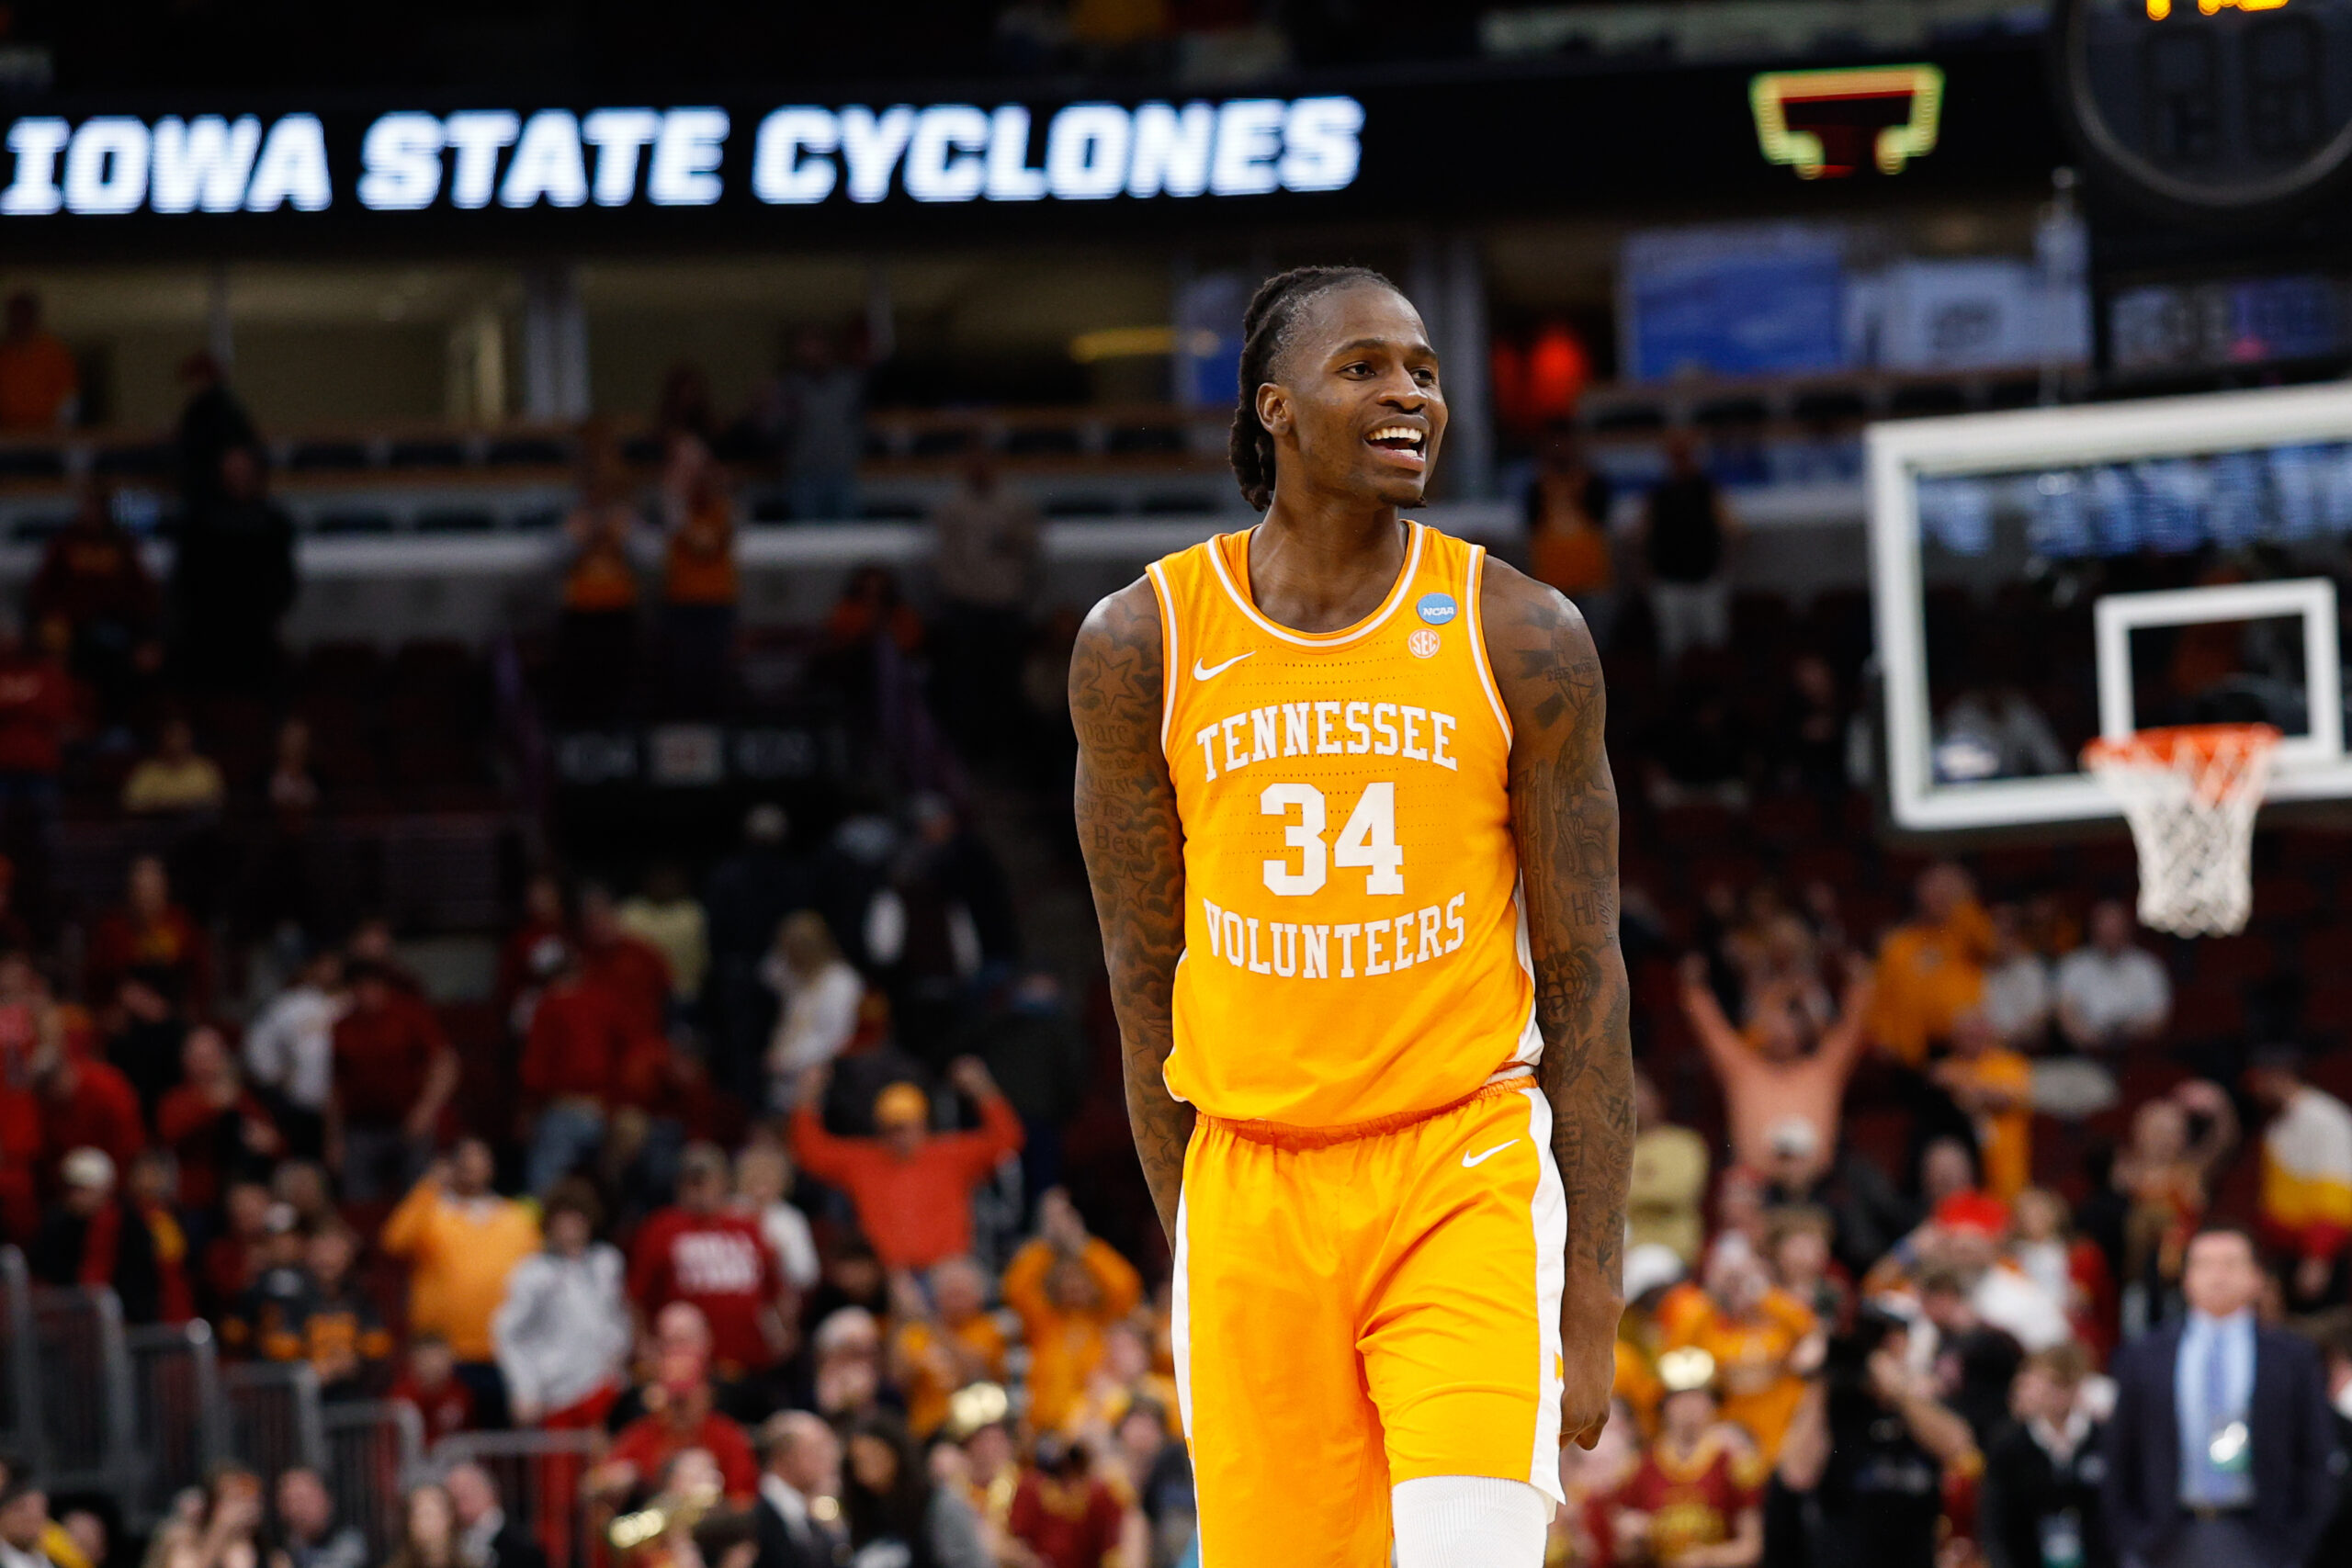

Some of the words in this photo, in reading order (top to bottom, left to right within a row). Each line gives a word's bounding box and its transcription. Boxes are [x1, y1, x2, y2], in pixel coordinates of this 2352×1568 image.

[0, 113, 333, 215] IOWA
[356, 105, 730, 210] STATE
[752, 96, 1365, 206] CYCLONES
[1410, 630, 1439, 655] SEC
[1422, 606, 1455, 617] NCAA
[1196, 701, 1458, 783] TENNESSEE
[1260, 782, 1404, 896] 34
[1203, 891, 1465, 978] VOLUNTEERS
